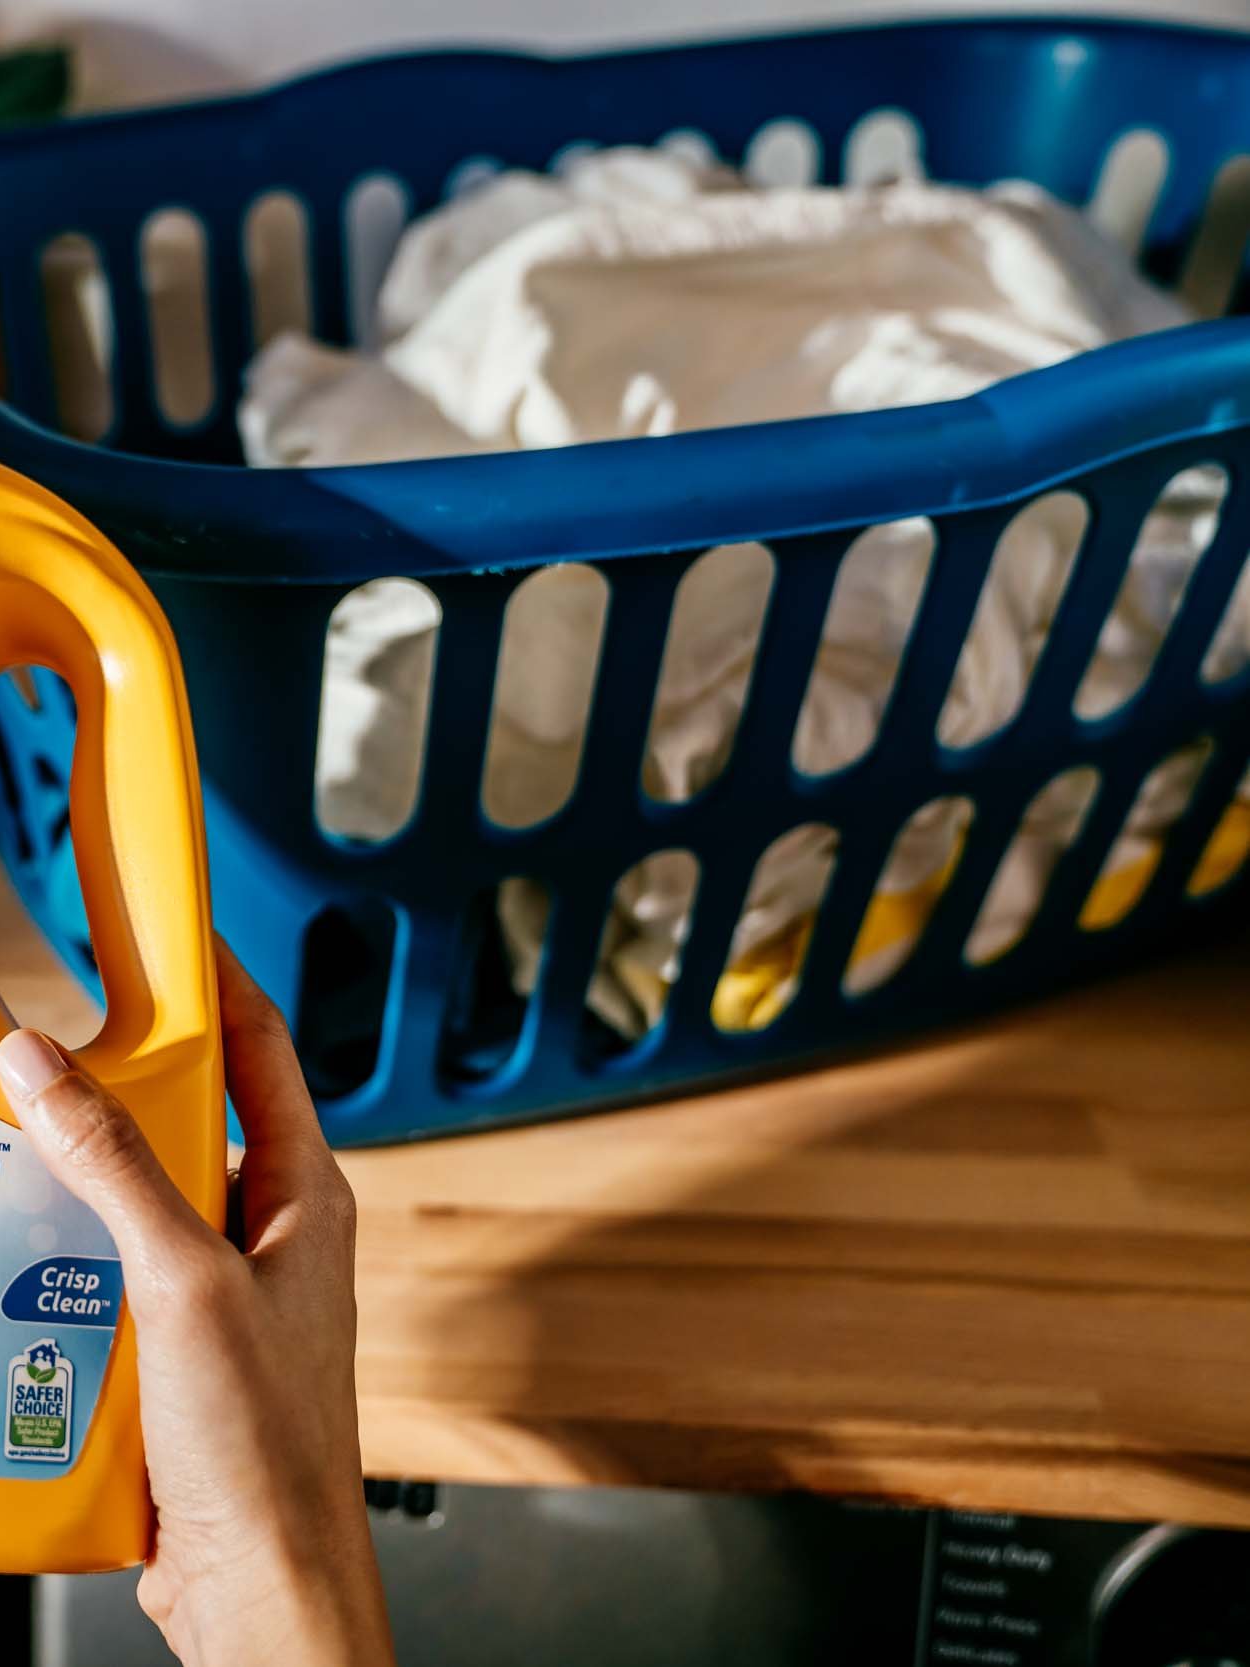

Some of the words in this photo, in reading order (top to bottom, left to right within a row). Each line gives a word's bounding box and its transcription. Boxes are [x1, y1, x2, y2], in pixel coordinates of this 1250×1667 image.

[41, 1267, 100, 1294] Crisp
[16, 1384, 64, 1402] SAFER
[14, 1400, 63, 1417] CHOICE
